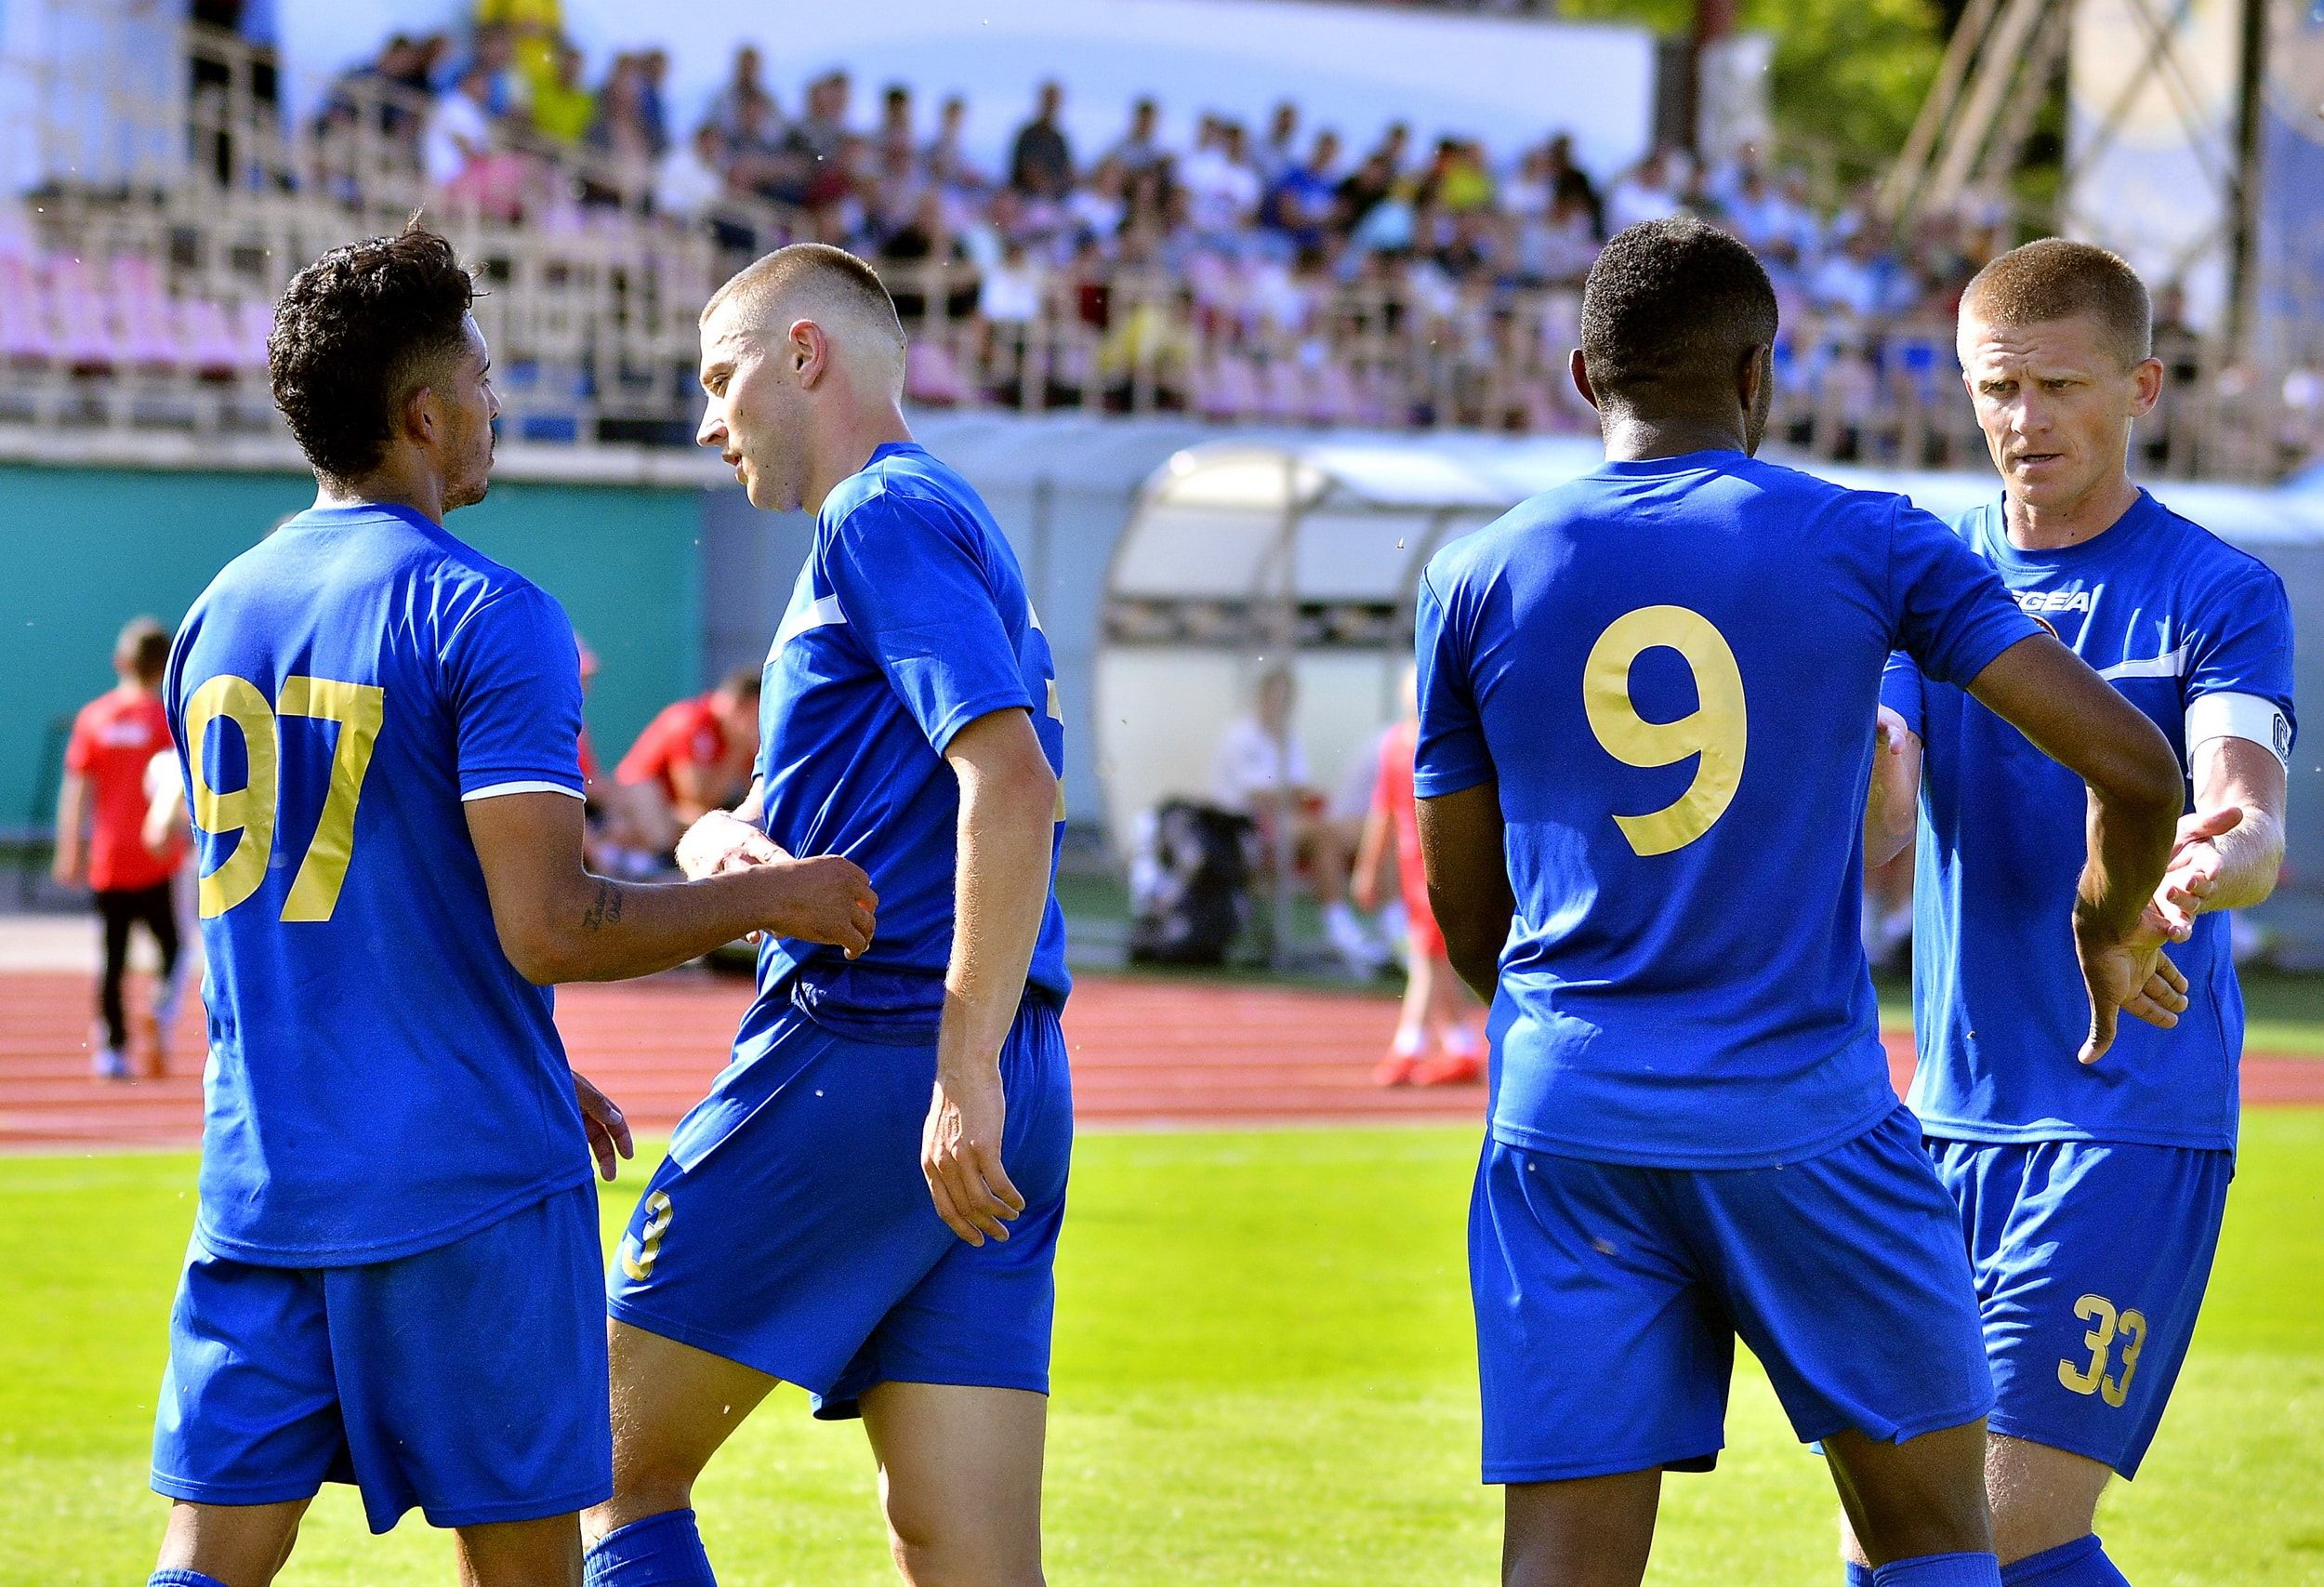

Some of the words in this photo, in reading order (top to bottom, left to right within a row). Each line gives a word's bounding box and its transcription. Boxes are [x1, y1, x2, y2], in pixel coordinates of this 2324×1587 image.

[186, 674, 384, 922] 97
[1583, 604, 1748, 856] 9
[621, 1189, 674, 1282] 3
[2057, 1293, 2147, 1408] 33
